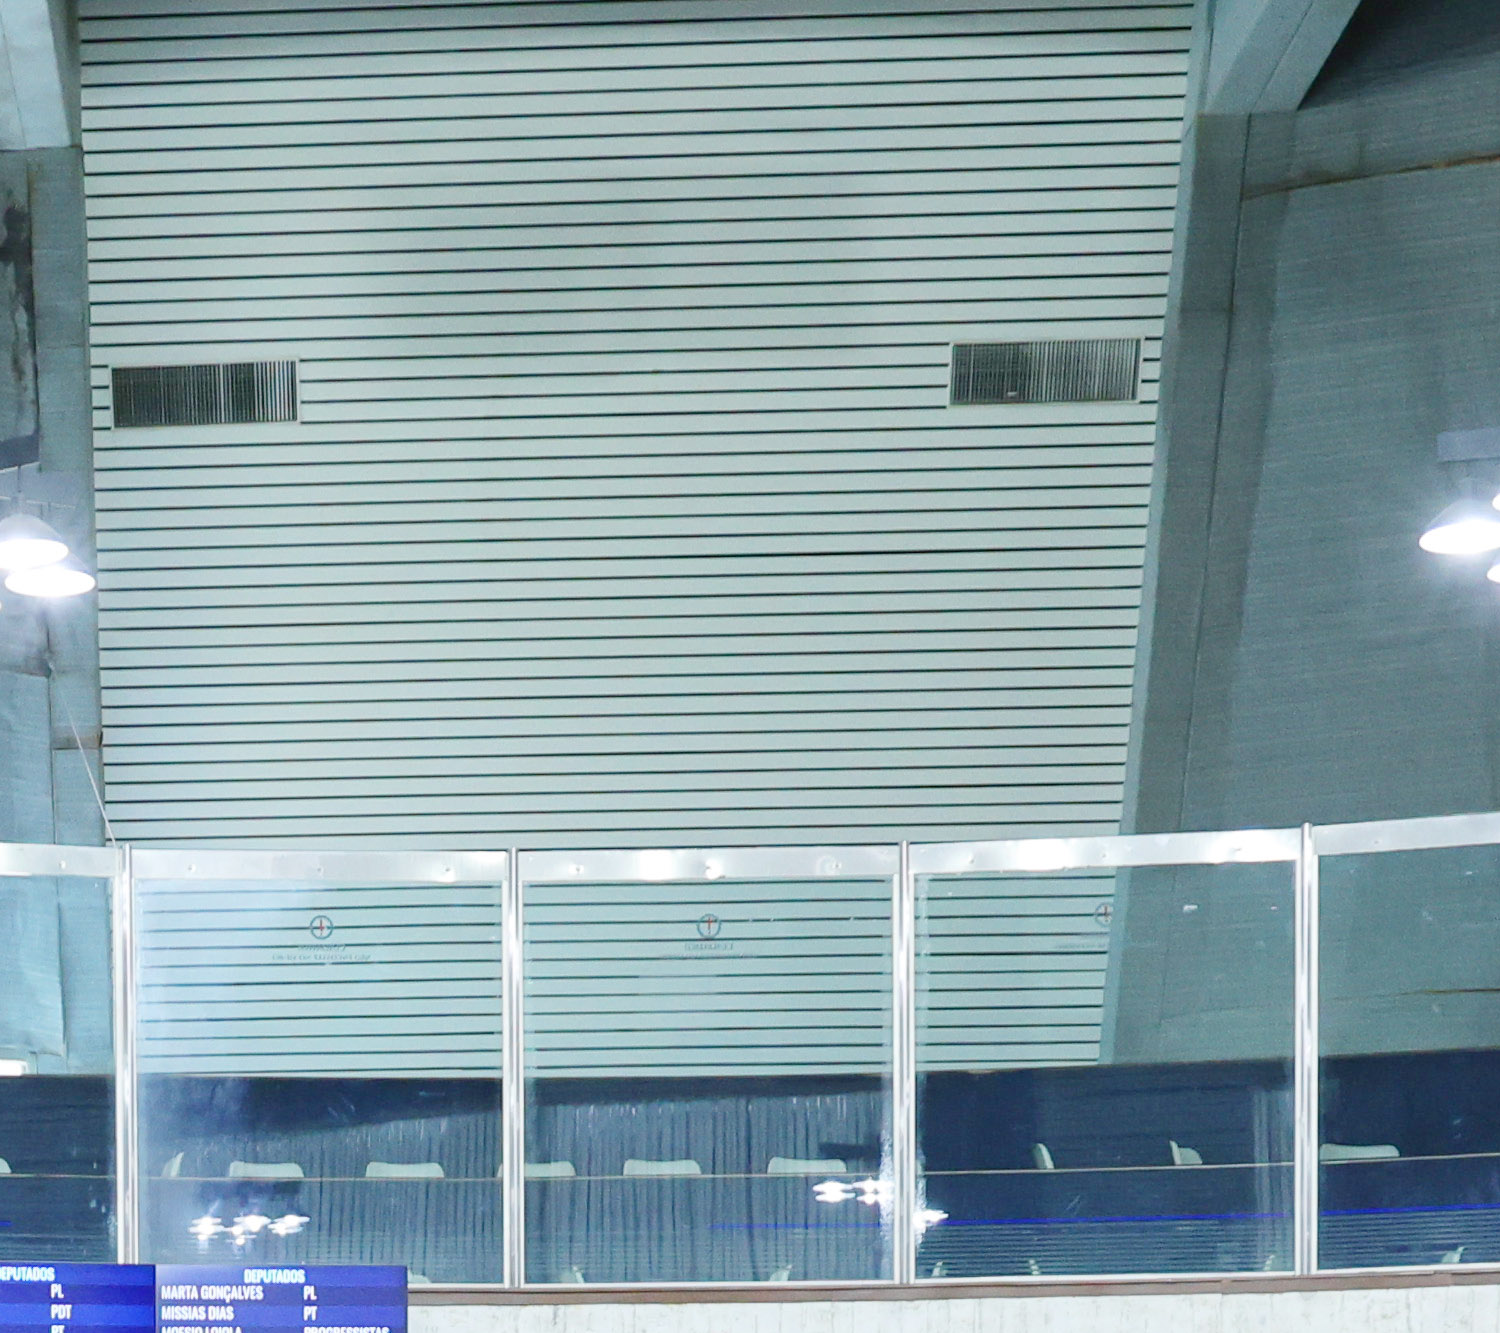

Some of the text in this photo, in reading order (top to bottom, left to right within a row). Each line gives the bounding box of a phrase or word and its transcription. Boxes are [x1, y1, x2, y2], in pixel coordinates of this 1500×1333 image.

[244, 1269, 306, 1283] DEPUTADOS
[51, 1284, 64, 1298] PL
[161, 1286, 264, 1303] MARTA GONÇALVES
[304, 1286, 317, 1301] PL
[51, 1305, 72, 1319] PDT
[161, 1306, 234, 1321] MISSIAS DIAS
[304, 1306, 317, 1321] PT
